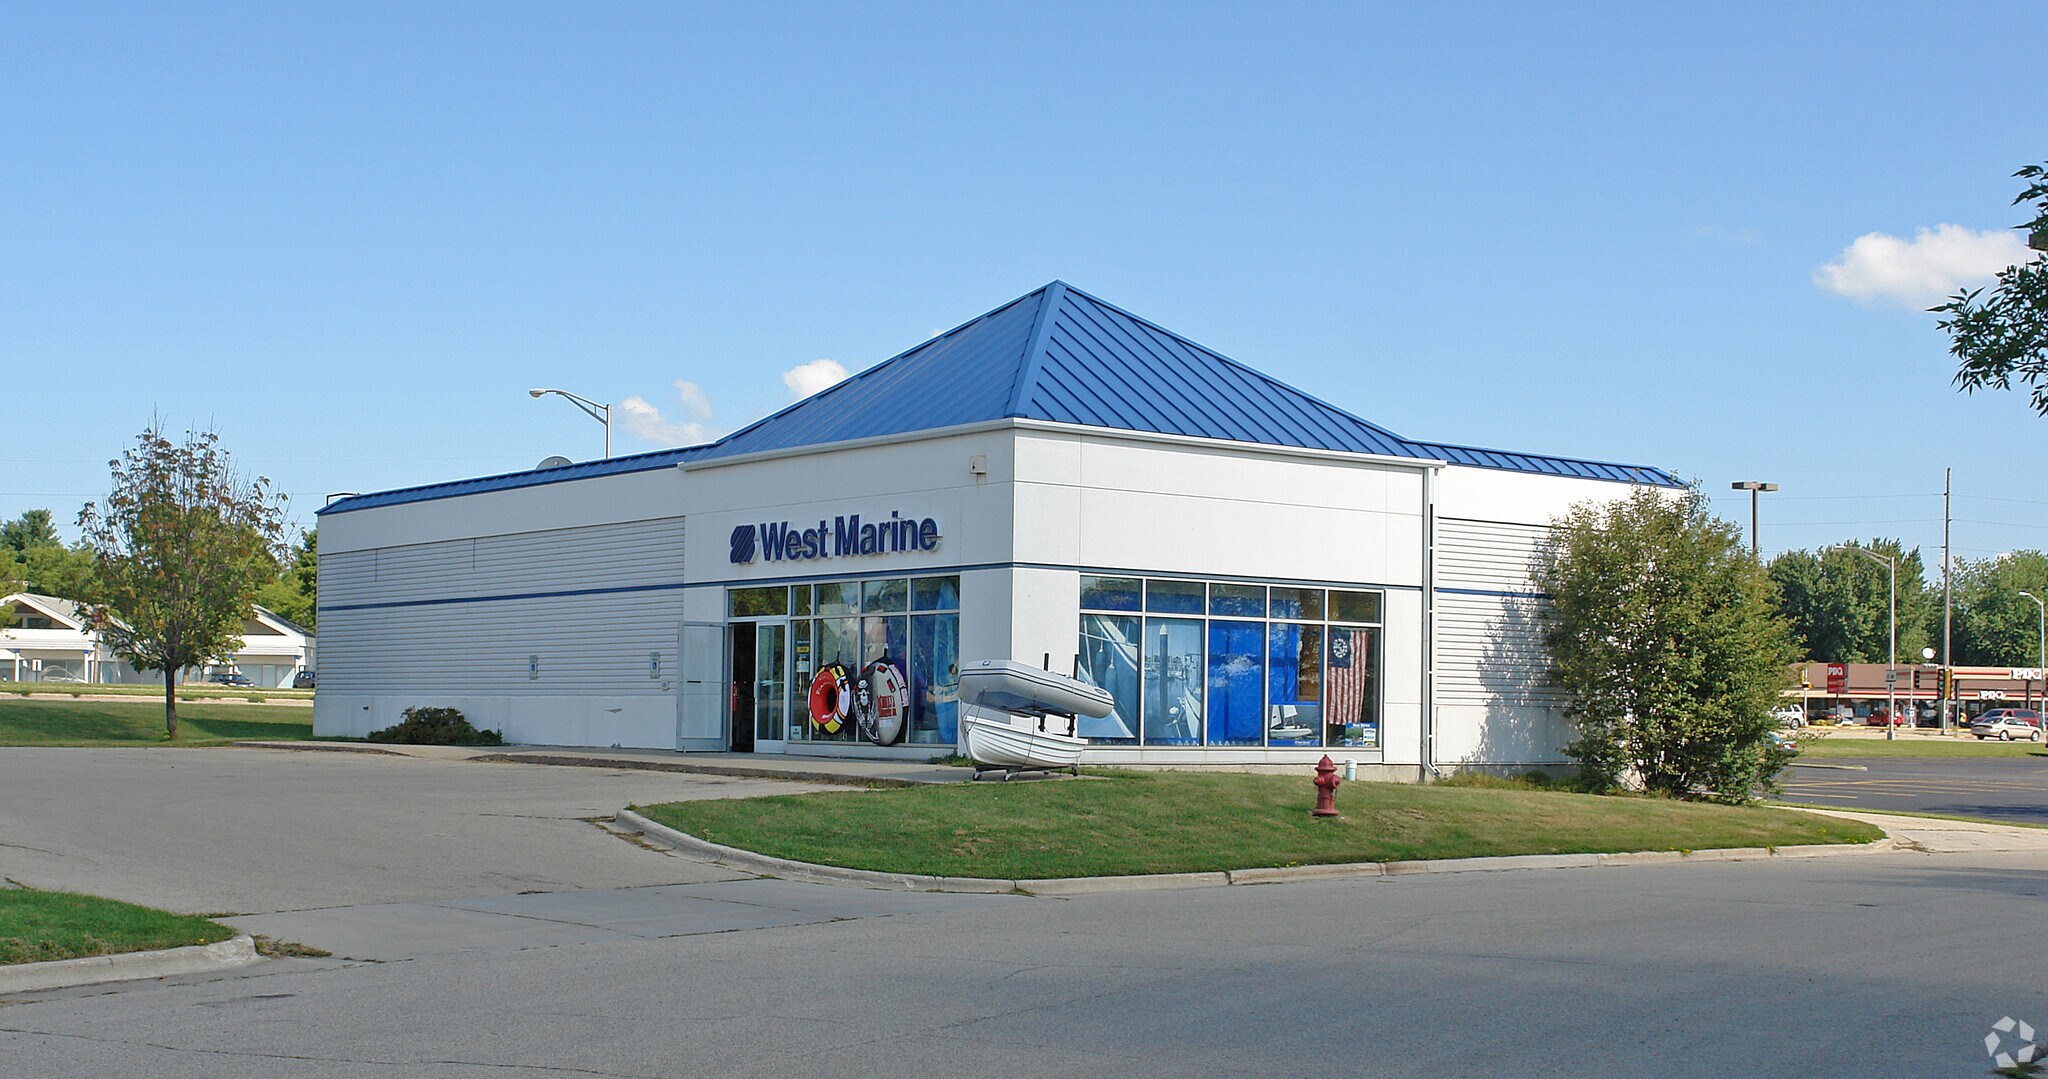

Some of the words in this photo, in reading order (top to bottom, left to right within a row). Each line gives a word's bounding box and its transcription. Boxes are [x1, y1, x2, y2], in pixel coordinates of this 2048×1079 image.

[759, 519, 830, 562] West
[834, 510, 940, 557] Marine
[1828, 667, 1844, 676] PDQ
